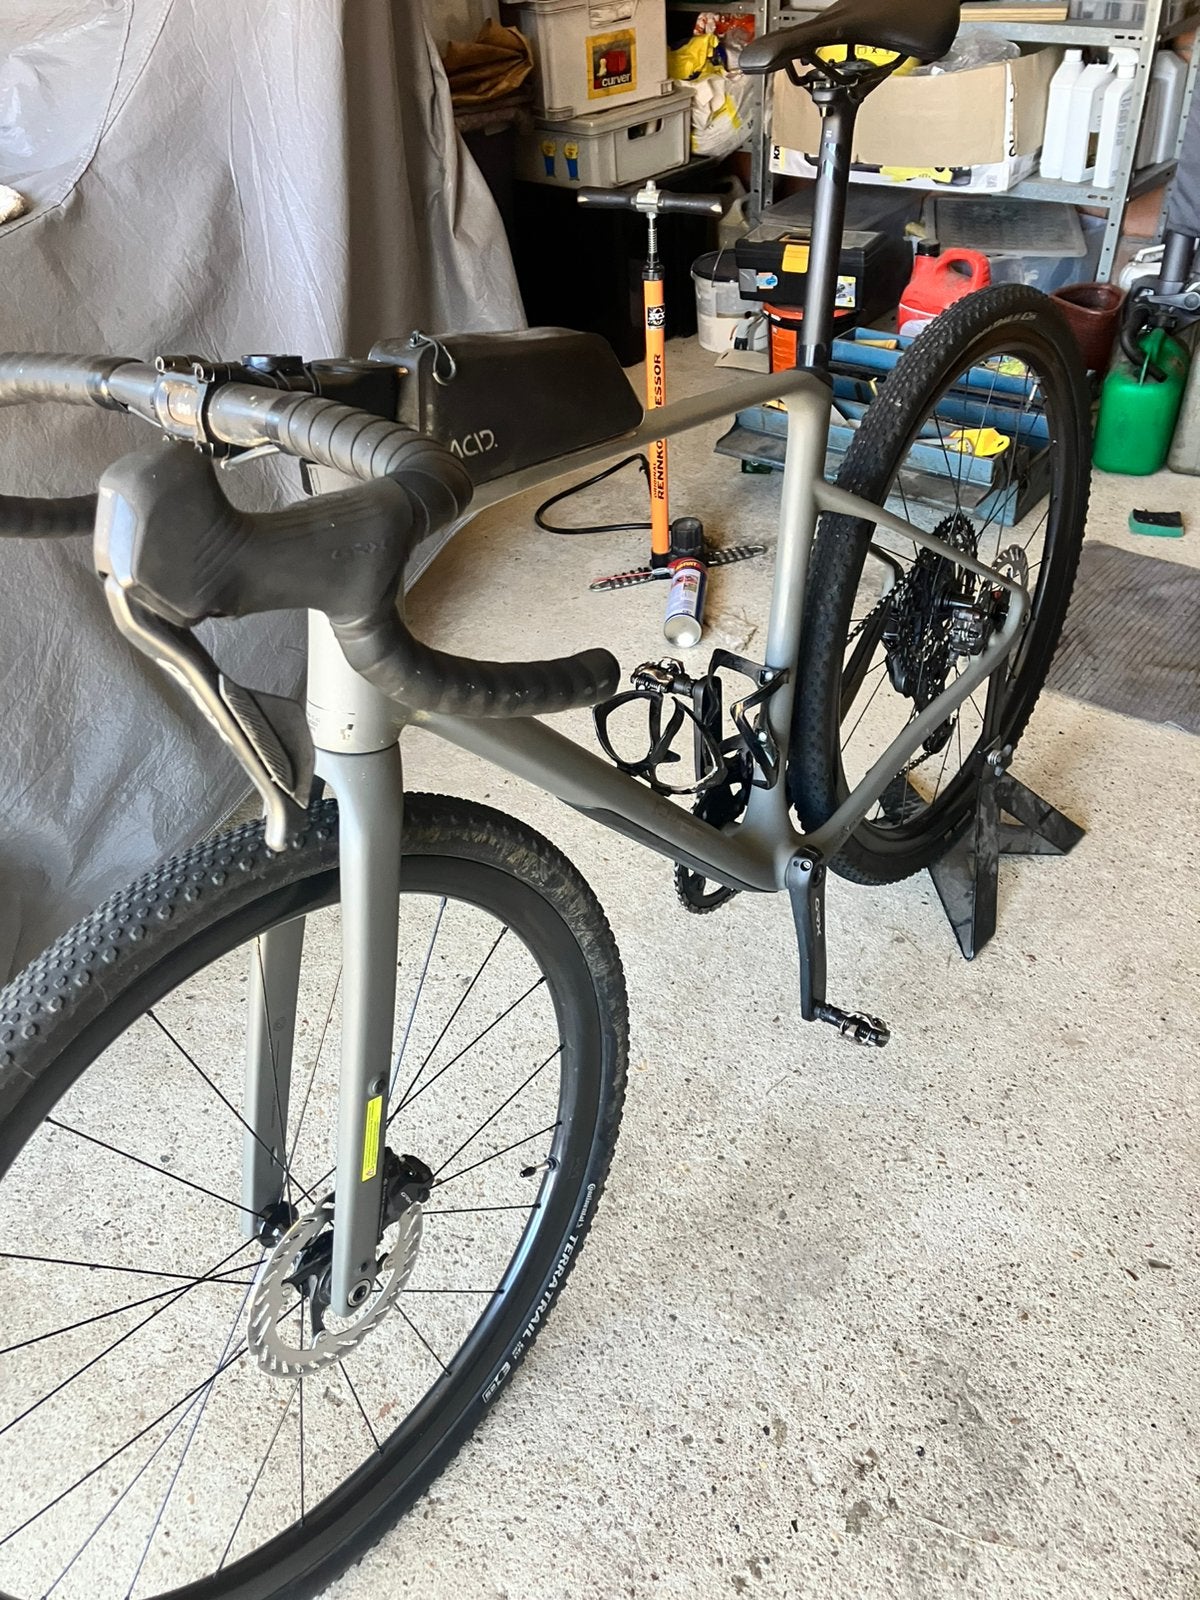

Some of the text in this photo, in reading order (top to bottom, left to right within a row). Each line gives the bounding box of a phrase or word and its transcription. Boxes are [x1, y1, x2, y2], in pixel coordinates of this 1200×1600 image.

[602, 74, 630, 87] curver
[522, 1235, 579, 1338] TERRA TRAIL
